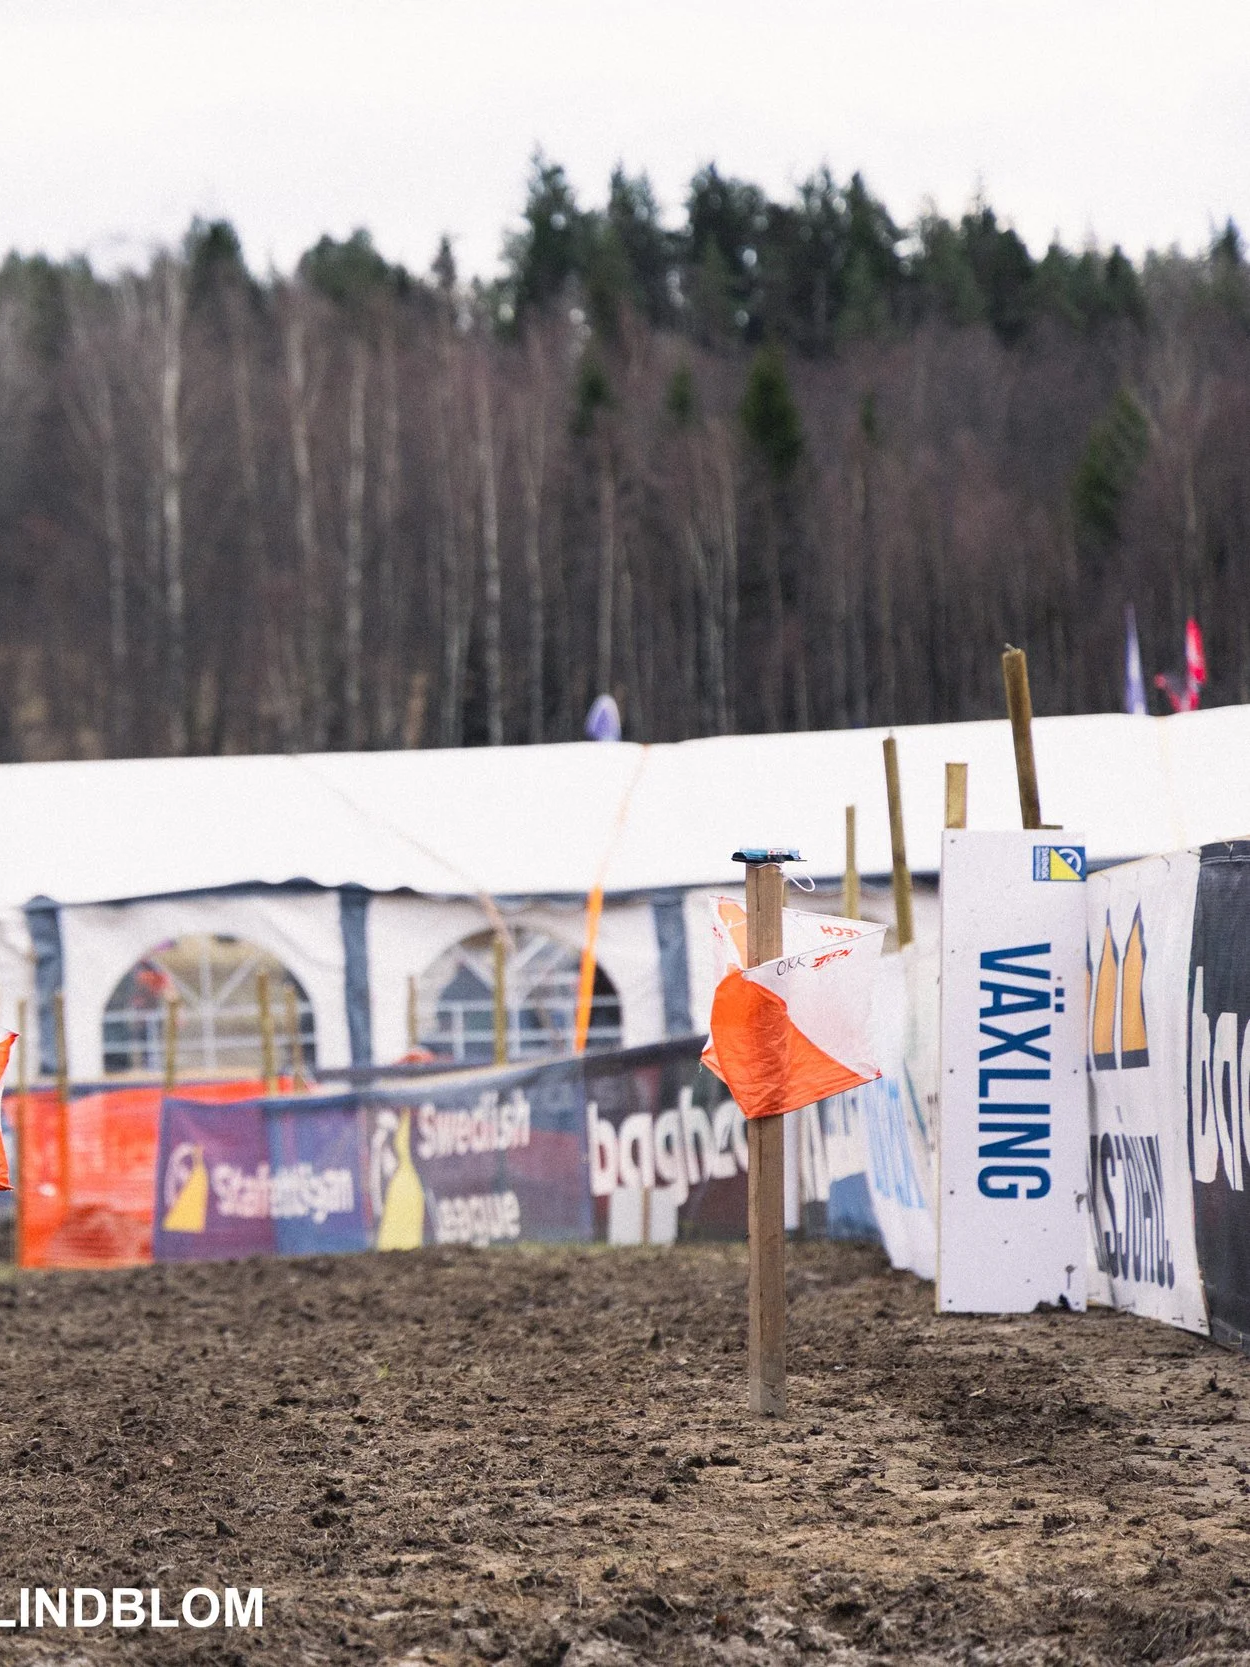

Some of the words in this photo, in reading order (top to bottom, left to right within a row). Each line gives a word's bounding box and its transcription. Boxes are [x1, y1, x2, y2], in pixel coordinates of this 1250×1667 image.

[417, 1088, 531, 1160] Swedish
[977, 942, 1065, 1200] VÄXLING
[1191, 965, 1250, 1191] ba
